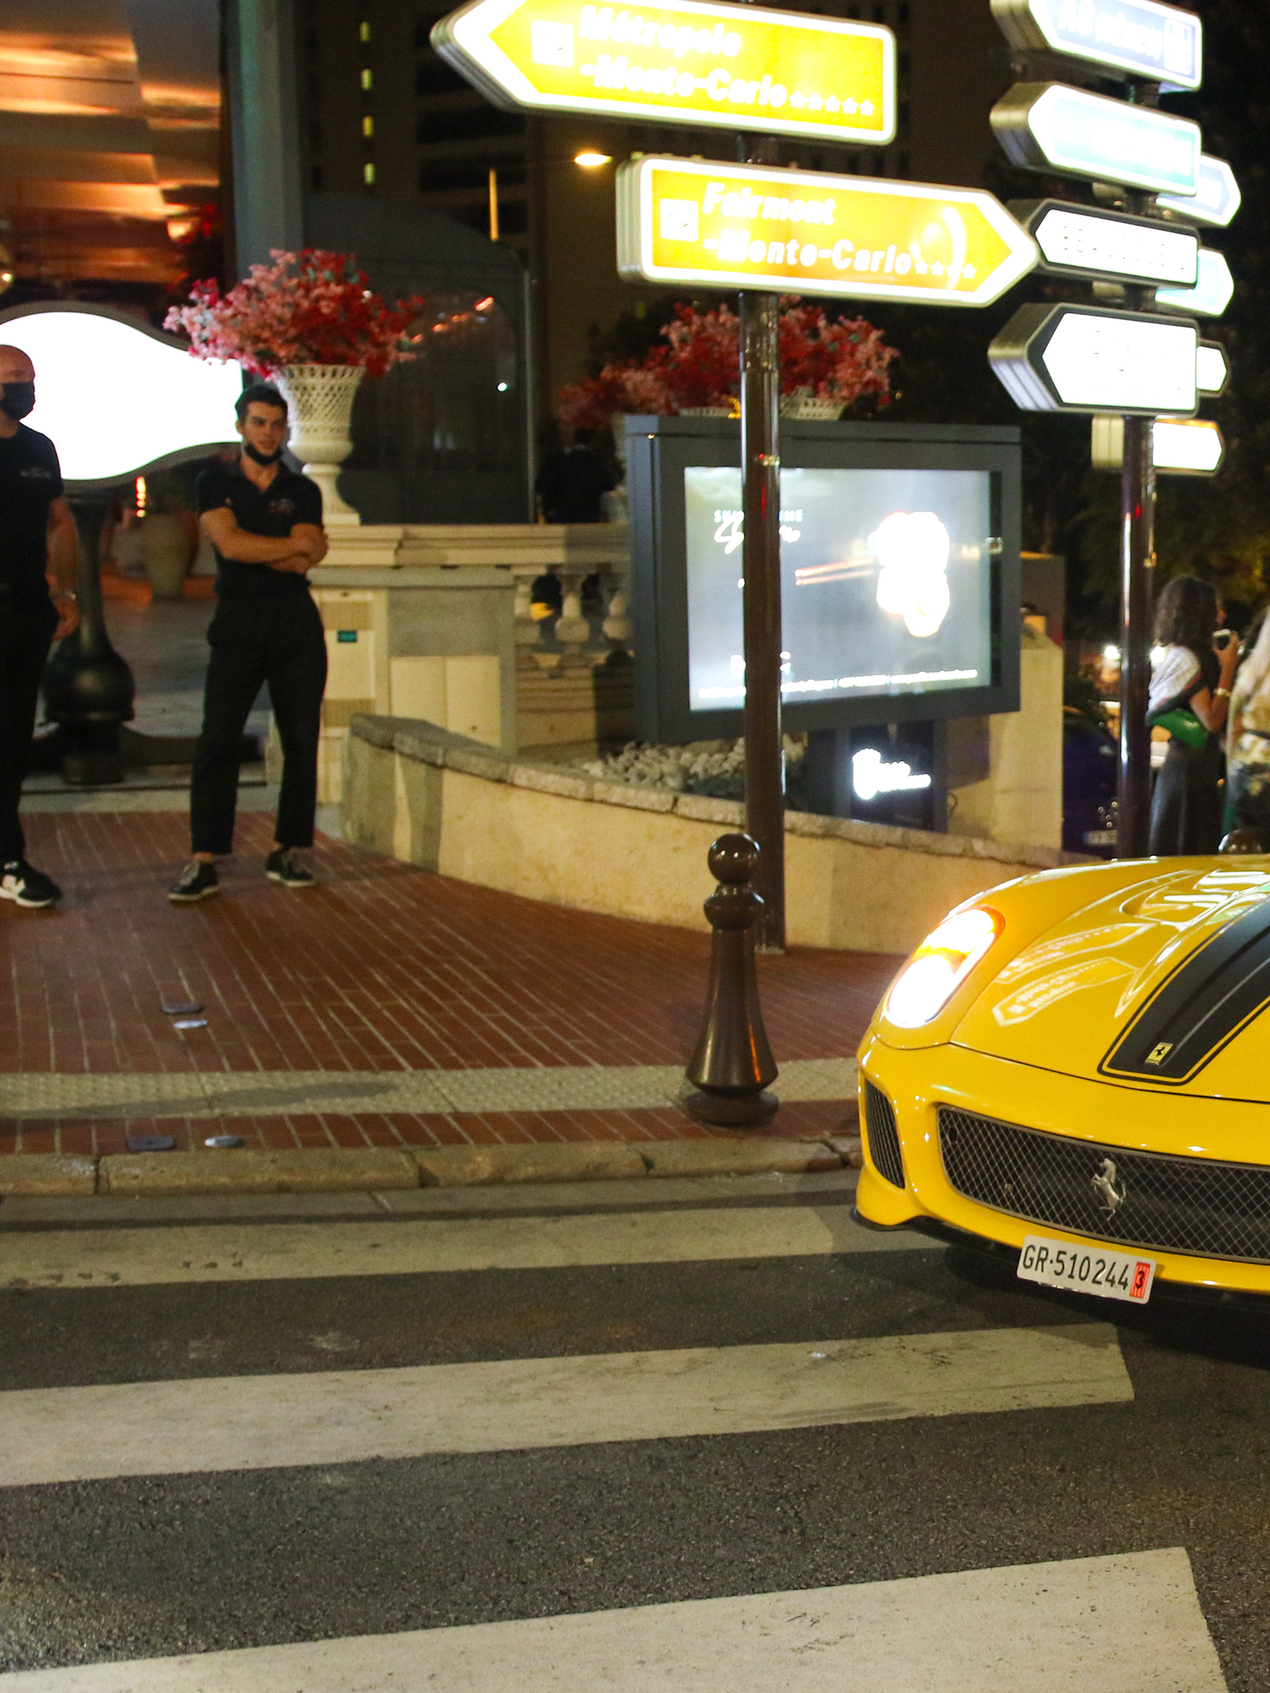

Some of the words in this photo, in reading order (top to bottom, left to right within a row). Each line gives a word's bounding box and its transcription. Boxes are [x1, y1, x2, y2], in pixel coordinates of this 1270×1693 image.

[579, 5, 742, 58] Métropole
[702, 181, 837, 226] Fairmont
[1135, 1270, 1146, 1290] 3
